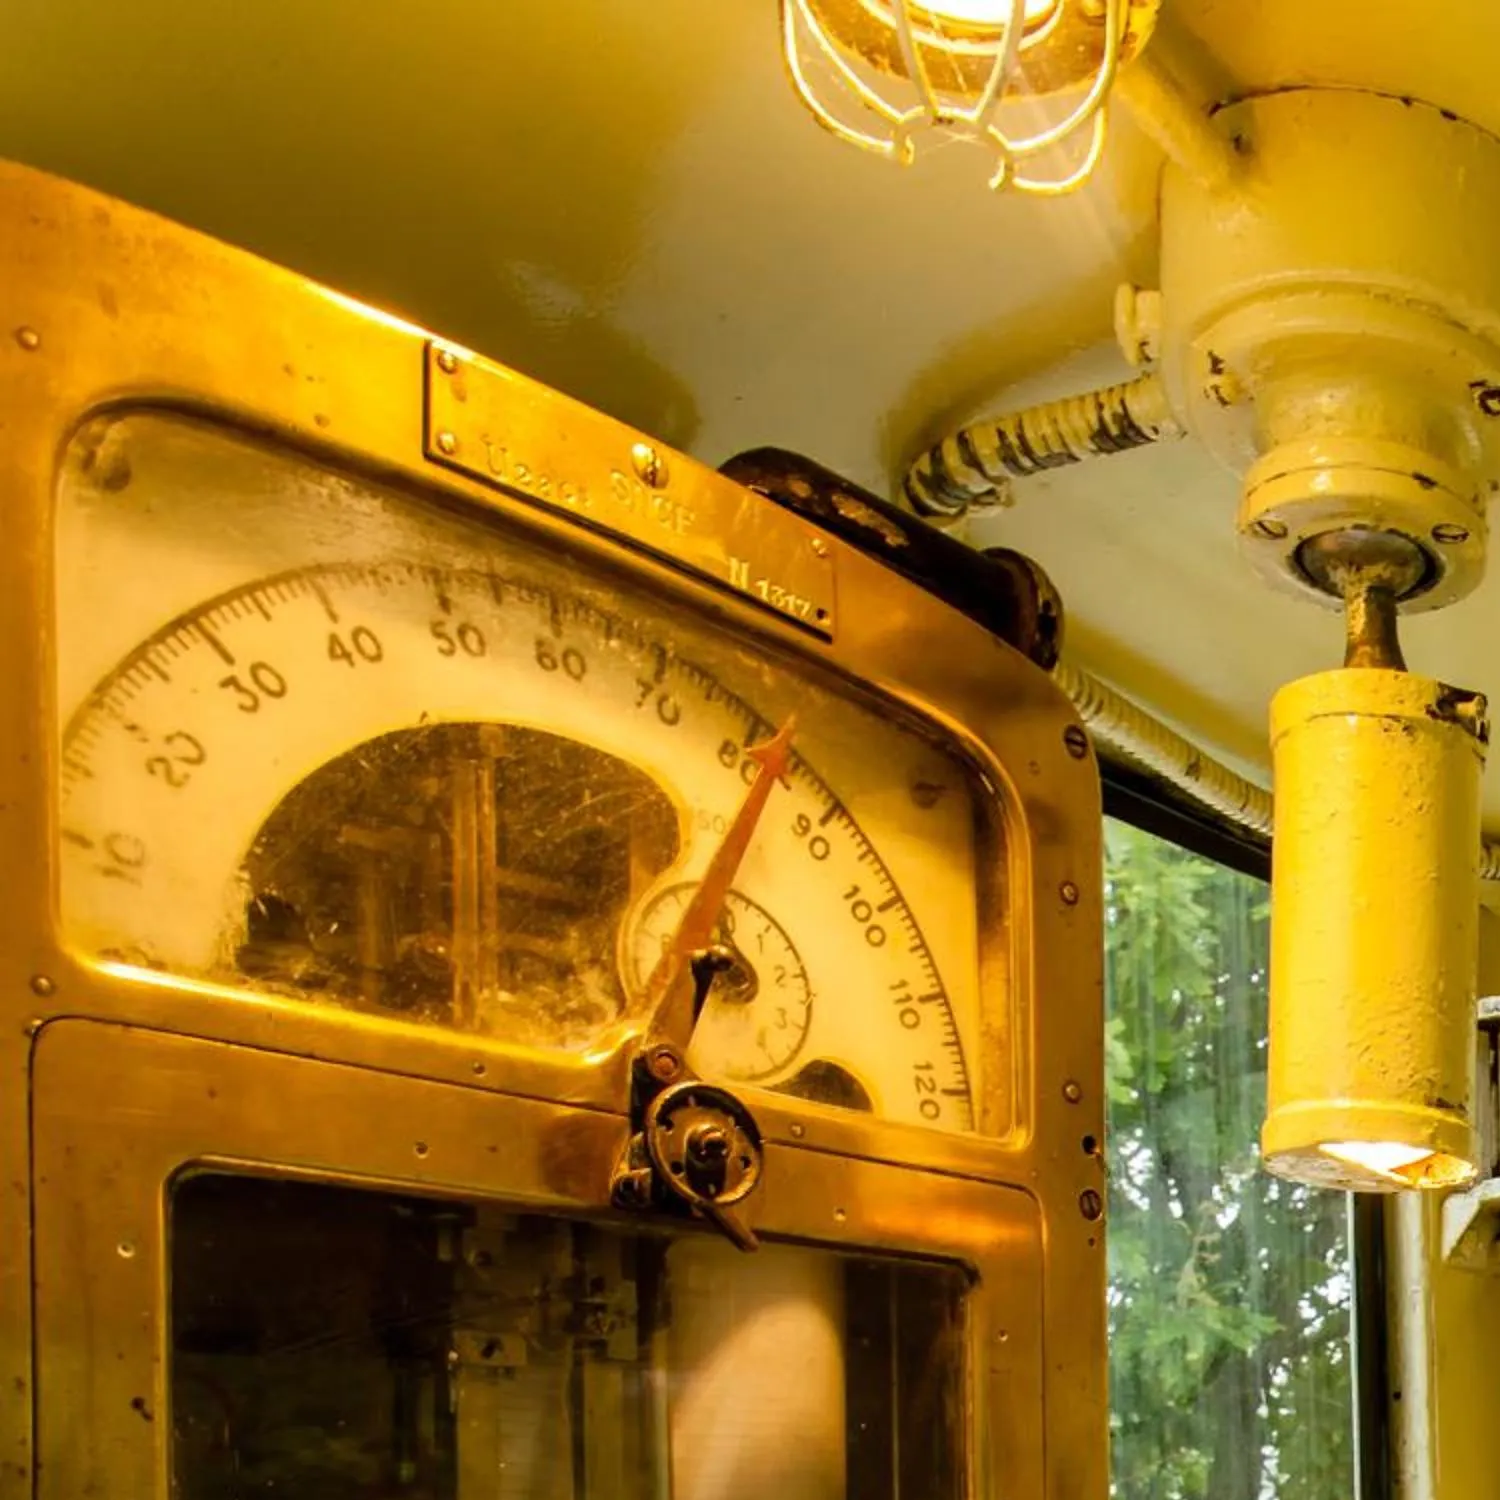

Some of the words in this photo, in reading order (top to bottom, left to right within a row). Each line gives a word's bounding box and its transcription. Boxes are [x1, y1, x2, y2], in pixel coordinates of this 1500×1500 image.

[327, 626, 383, 668] 40
[429, 621, 486, 658] 50
[535, 640, 586, 682] 60
[219, 661, 287, 713] 30
[634, 681, 681, 726] 70
[145, 729, 207, 787] 20
[791, 812, 831, 862] 90
[843, 885, 887, 949] 100
[889, 979, 921, 1031] 110
[912, 1061, 942, 1122] 120
